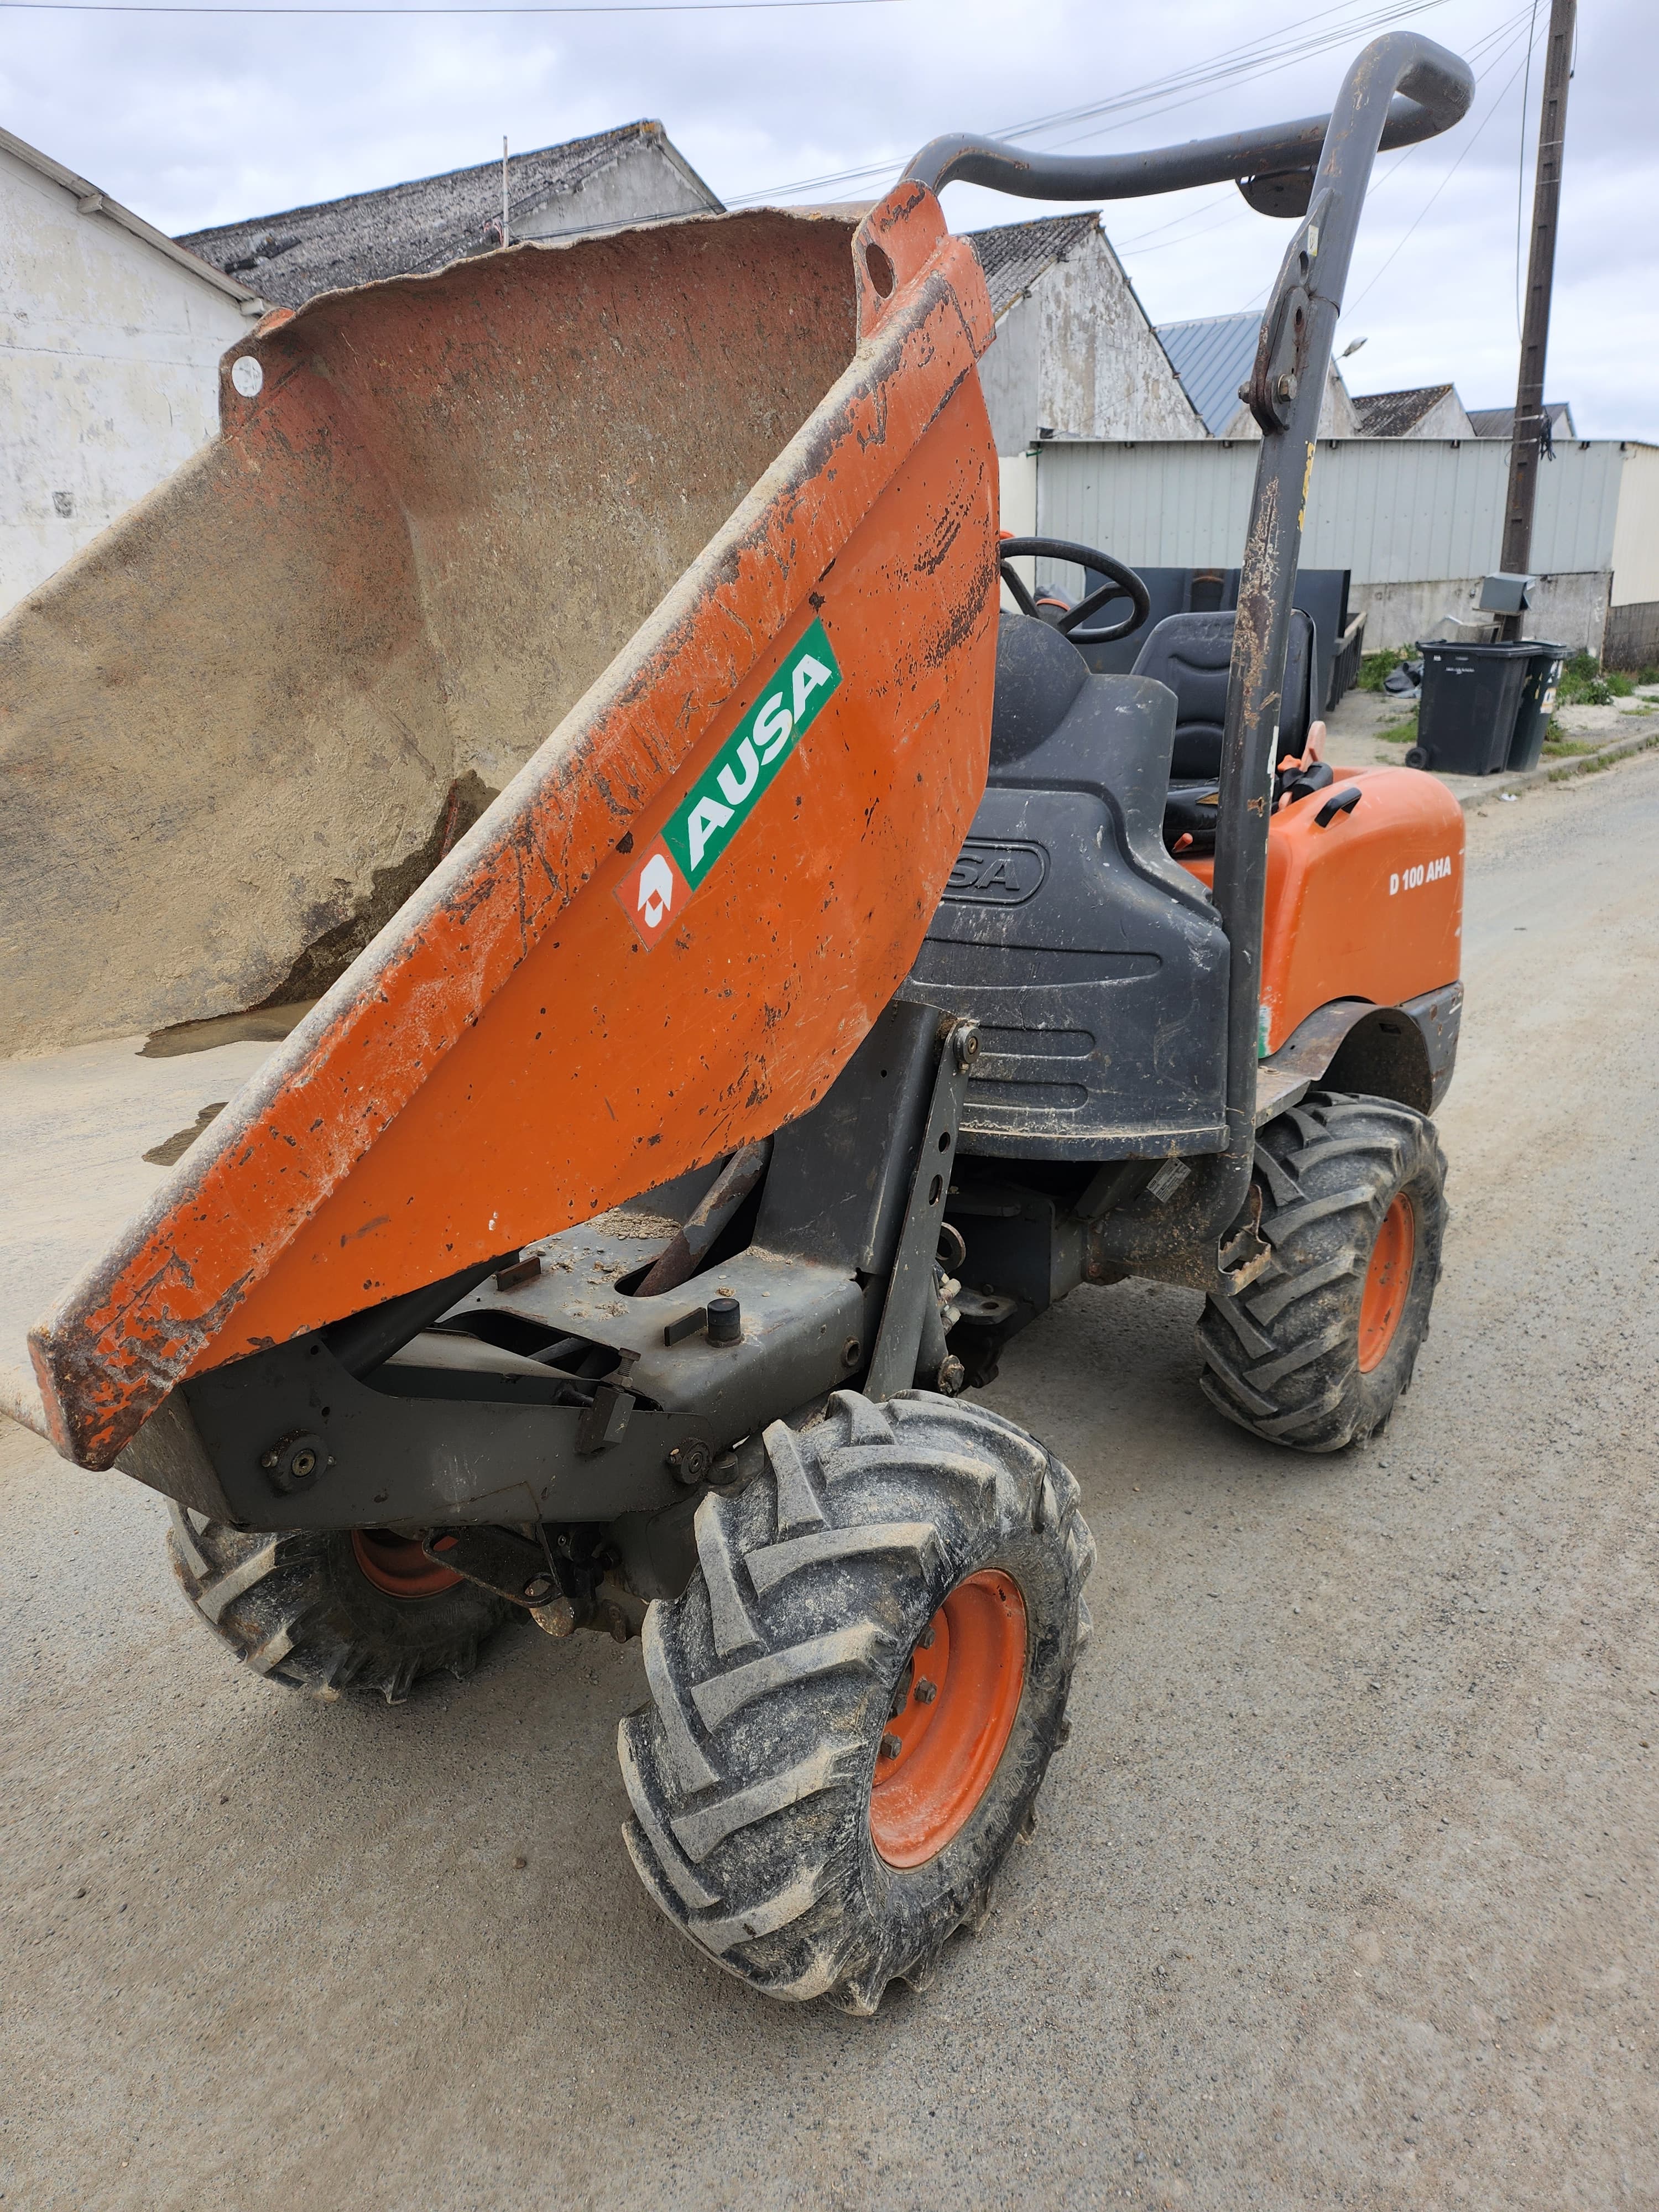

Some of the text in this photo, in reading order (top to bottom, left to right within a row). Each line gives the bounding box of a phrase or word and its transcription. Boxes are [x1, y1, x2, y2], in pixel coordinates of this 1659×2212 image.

[687, 654, 832, 872] AUSA
[946, 854, 1020, 890] SA
[1389, 855, 1451, 895] D 100 AHA
